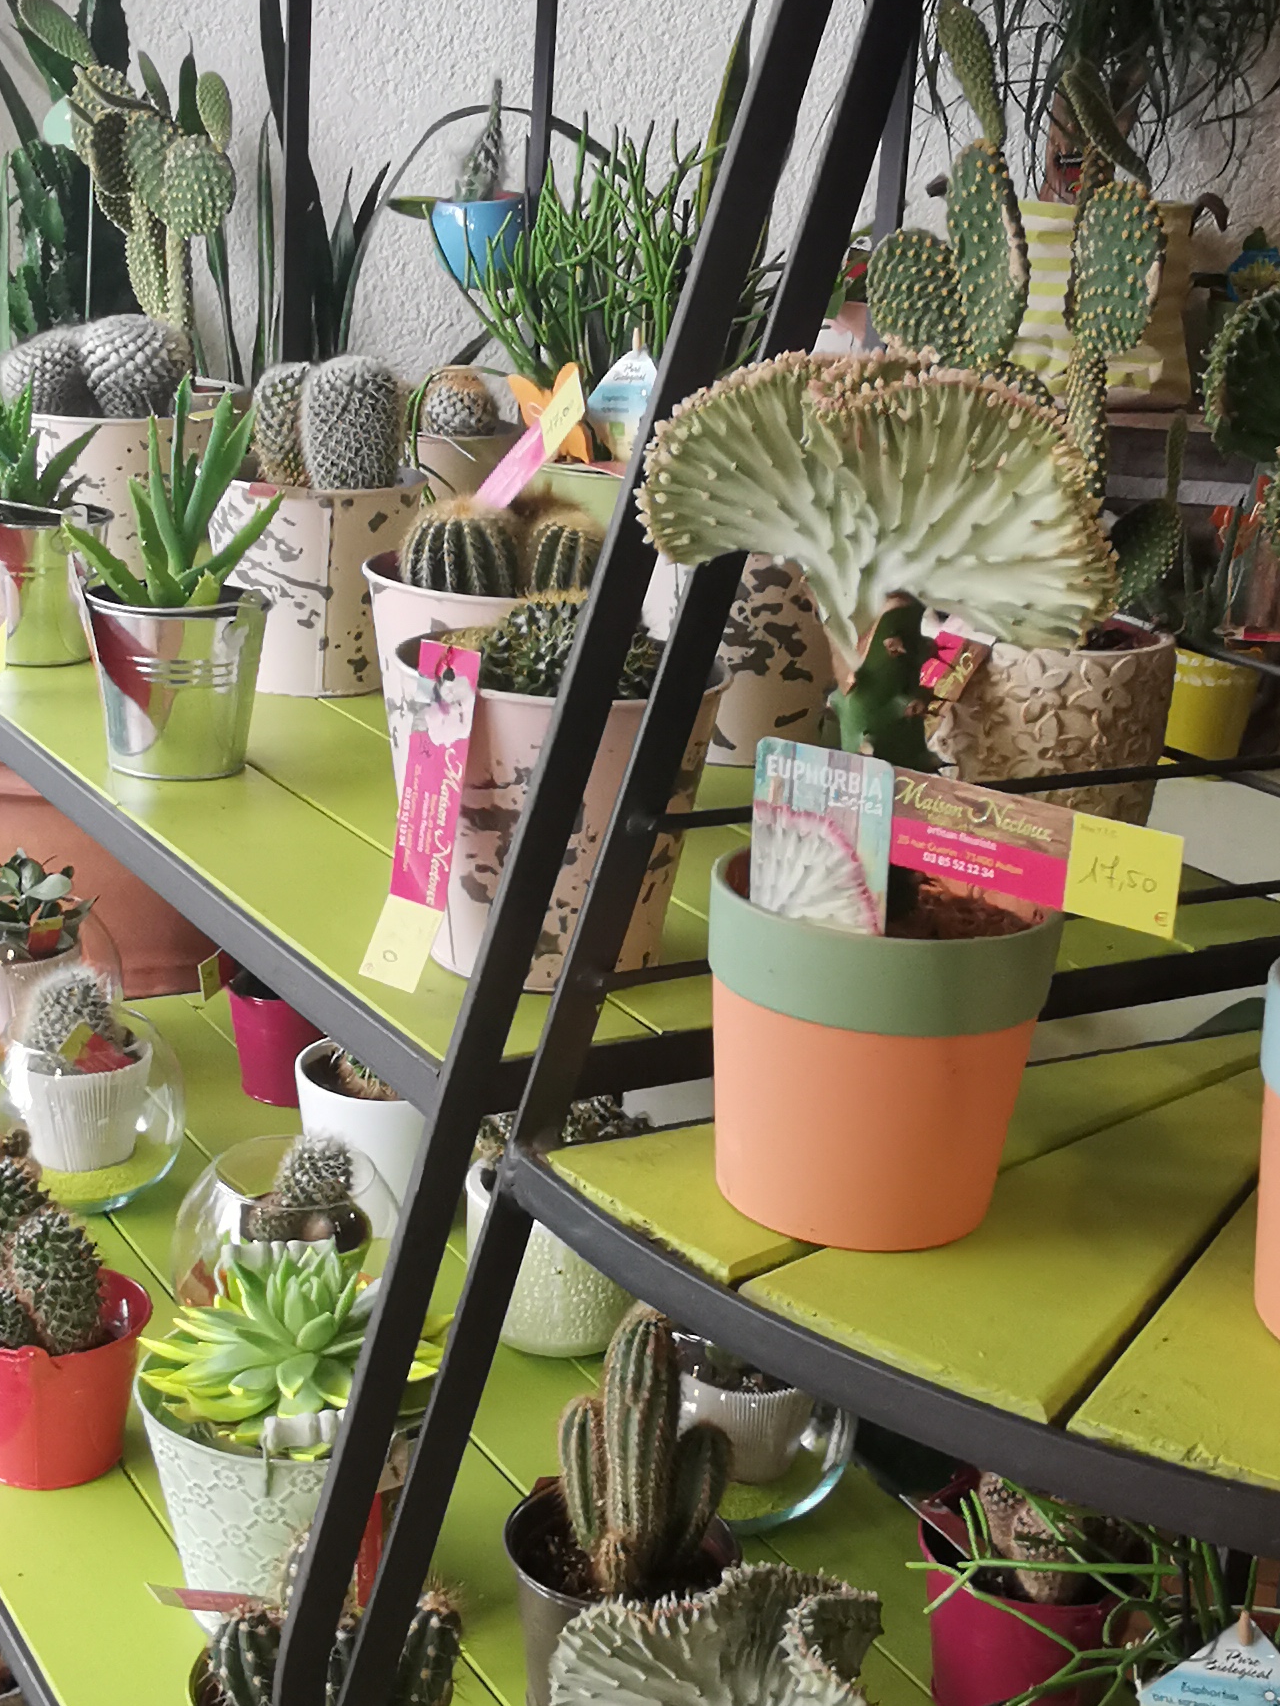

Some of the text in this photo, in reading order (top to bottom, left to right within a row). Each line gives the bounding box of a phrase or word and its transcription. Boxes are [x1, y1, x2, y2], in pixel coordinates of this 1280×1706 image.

[766, 753, 883, 800] EUPHORBIA
[894, 776, 963, 819] Maison
[1076, 855, 1158, 893] 17,50
